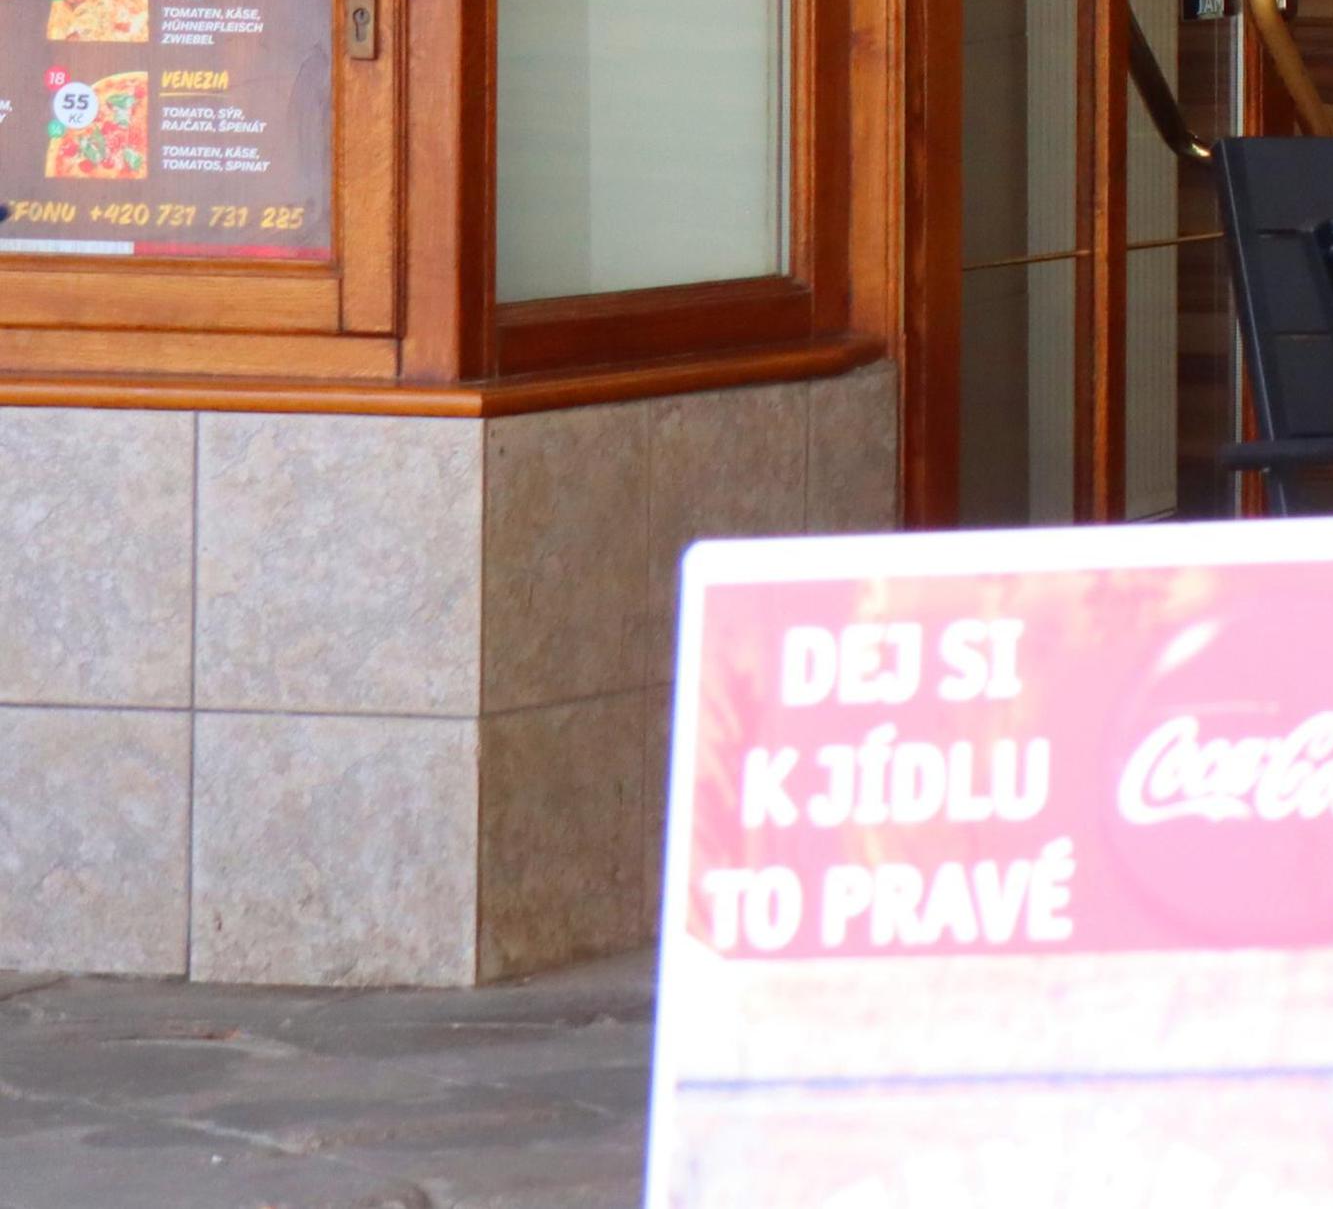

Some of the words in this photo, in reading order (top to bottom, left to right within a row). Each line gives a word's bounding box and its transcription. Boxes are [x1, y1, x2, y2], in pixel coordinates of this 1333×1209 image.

[163, 8, 223, 20] TOMATEN,
[226, 7, 260, 21] KÄSE,
[162, 20, 263, 33] HÜHNERFLEISCH
[161, 34, 215, 45] ZWIEBEL
[162, 70, 229, 89] VENEZIA
[62, 94, 90, 110] 55
[162, 108, 215, 120] TOMATO,
[218, 106, 244, 120] SÝR,
[162, 119, 217, 133] RAJČATA,
[219, 119, 266, 134] ŠPENÁT
[162, 146, 222, 158] TOMATEN,
[225, 145, 260, 159] KÄSE,
[162, 160, 223, 172] TOMATOS,
[225, 161, 270, 172] SPINAT
[90, 204, 150, 226] +420
[156, 204, 196, 226] 731
[208, 206, 248, 228] 731
[780, 623, 923, 707] DEJ
[938, 618, 1024, 700] SI
[741, 746, 798, 829] K
[805, 723, 1051, 828] JÍDLU
[703, 864, 801, 949] TO
[821, 836, 1076, 948] PRAVÉ
